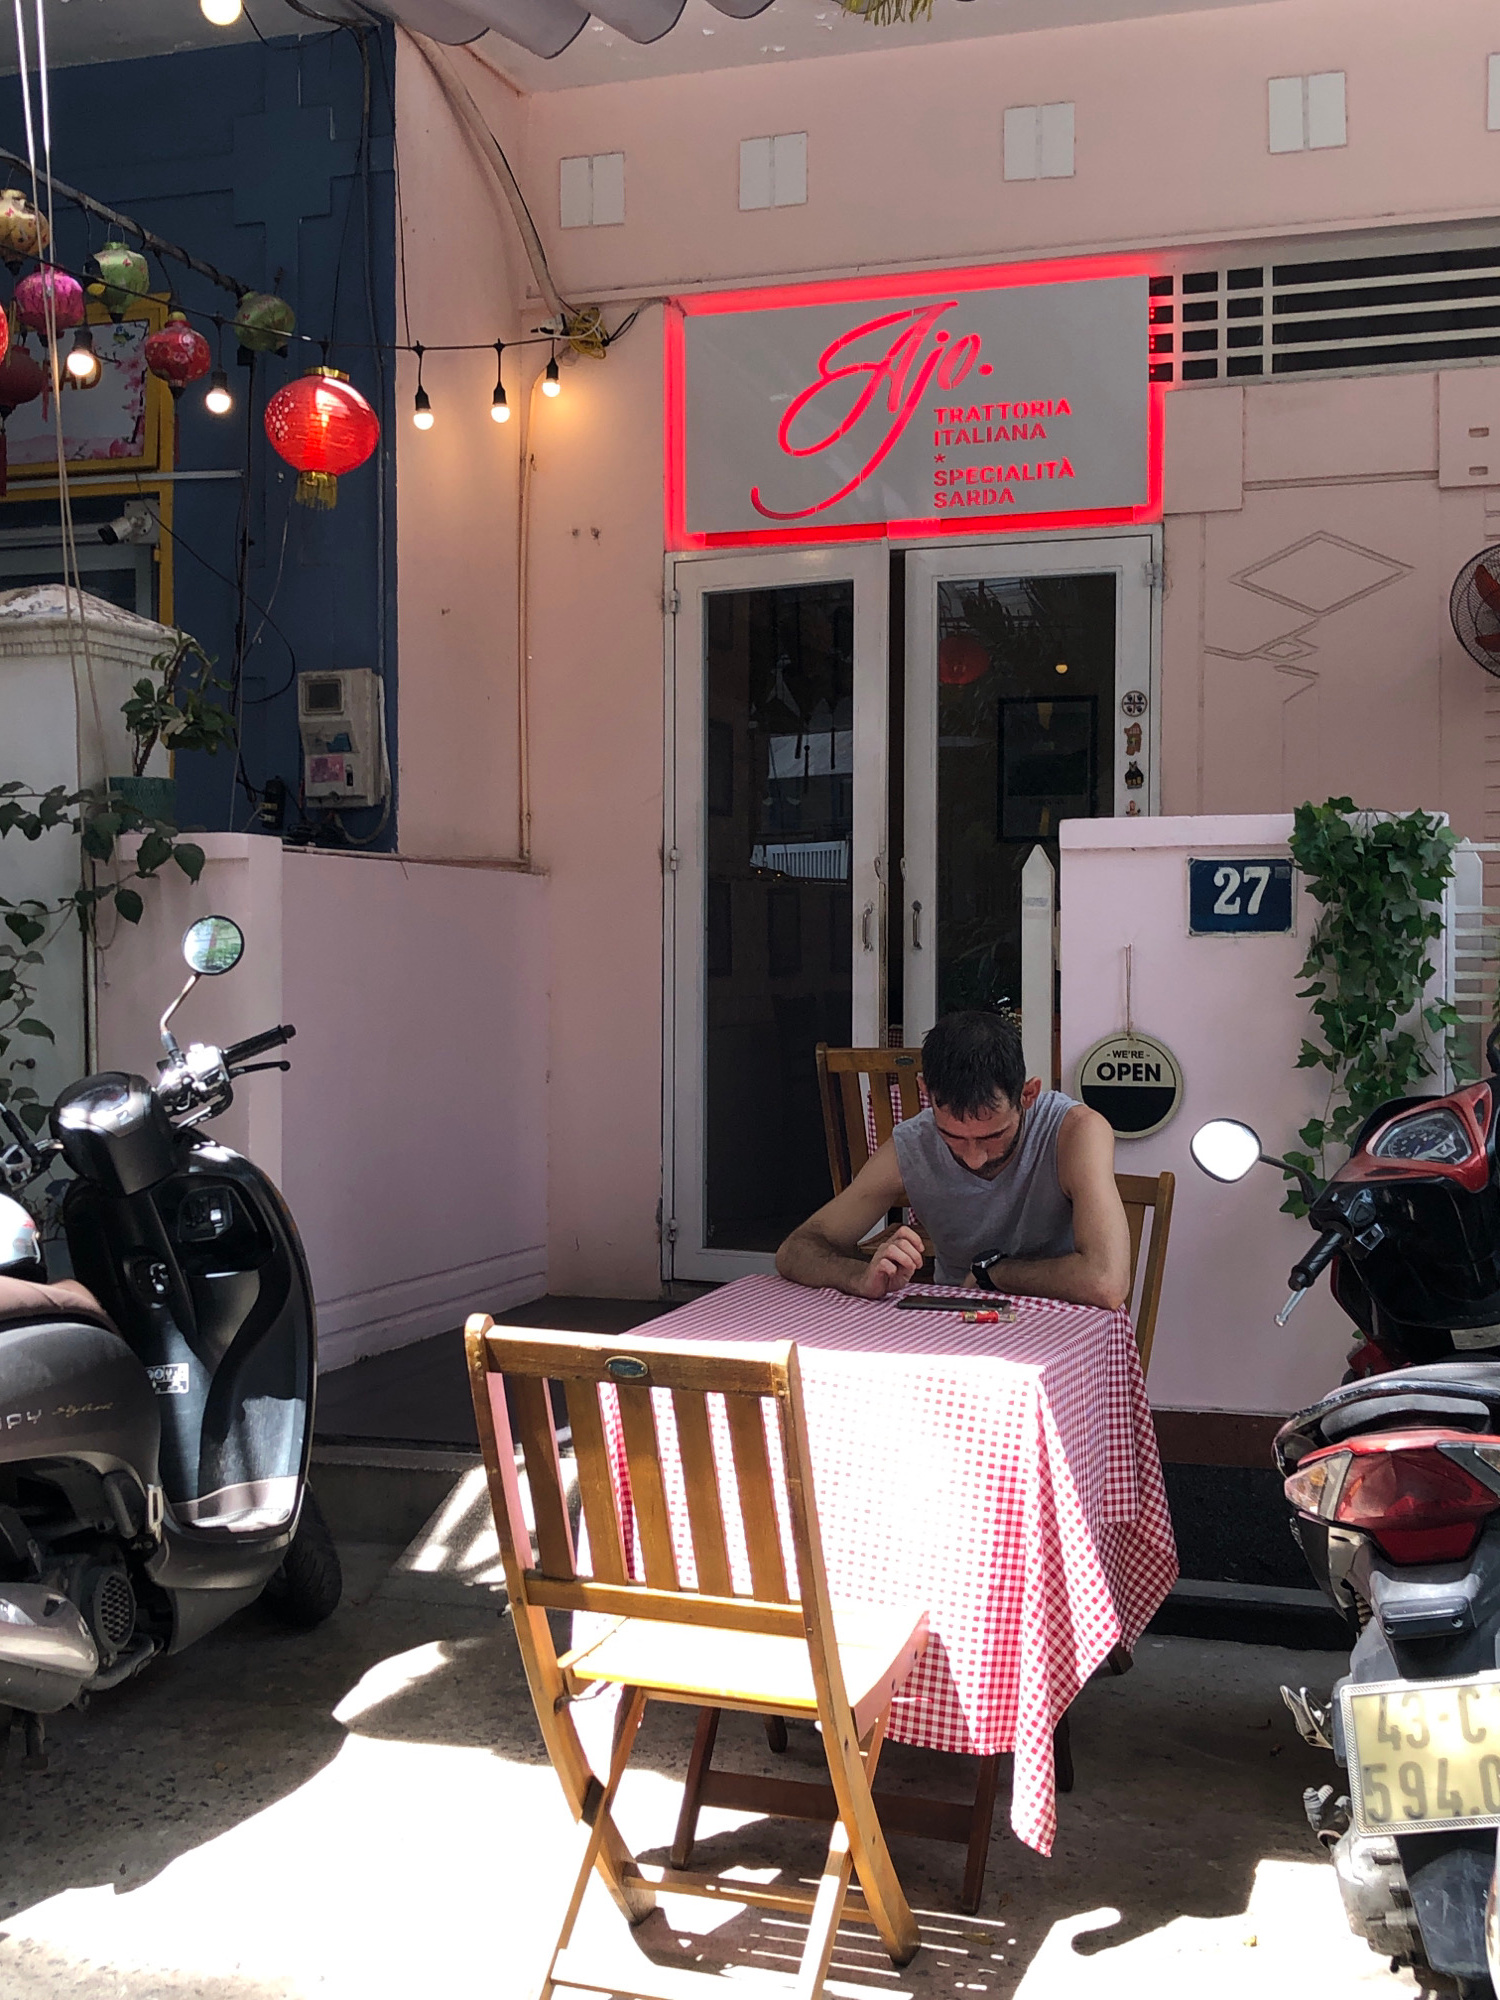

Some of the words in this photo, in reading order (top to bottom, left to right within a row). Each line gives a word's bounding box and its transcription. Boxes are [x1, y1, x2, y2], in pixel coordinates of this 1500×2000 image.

[933, 397, 1072, 425] TRATTORIA
[933, 422, 1047, 447] ITALIANA
[933, 455, 1076, 487] SPECIALITÀ
[933, 487, 1016, 509] SARDA
[1213, 866, 1272, 915] 27
[1112, 1050, 1145, 1059] WE'RE
[1096, 1062, 1162, 1082] OPEN
